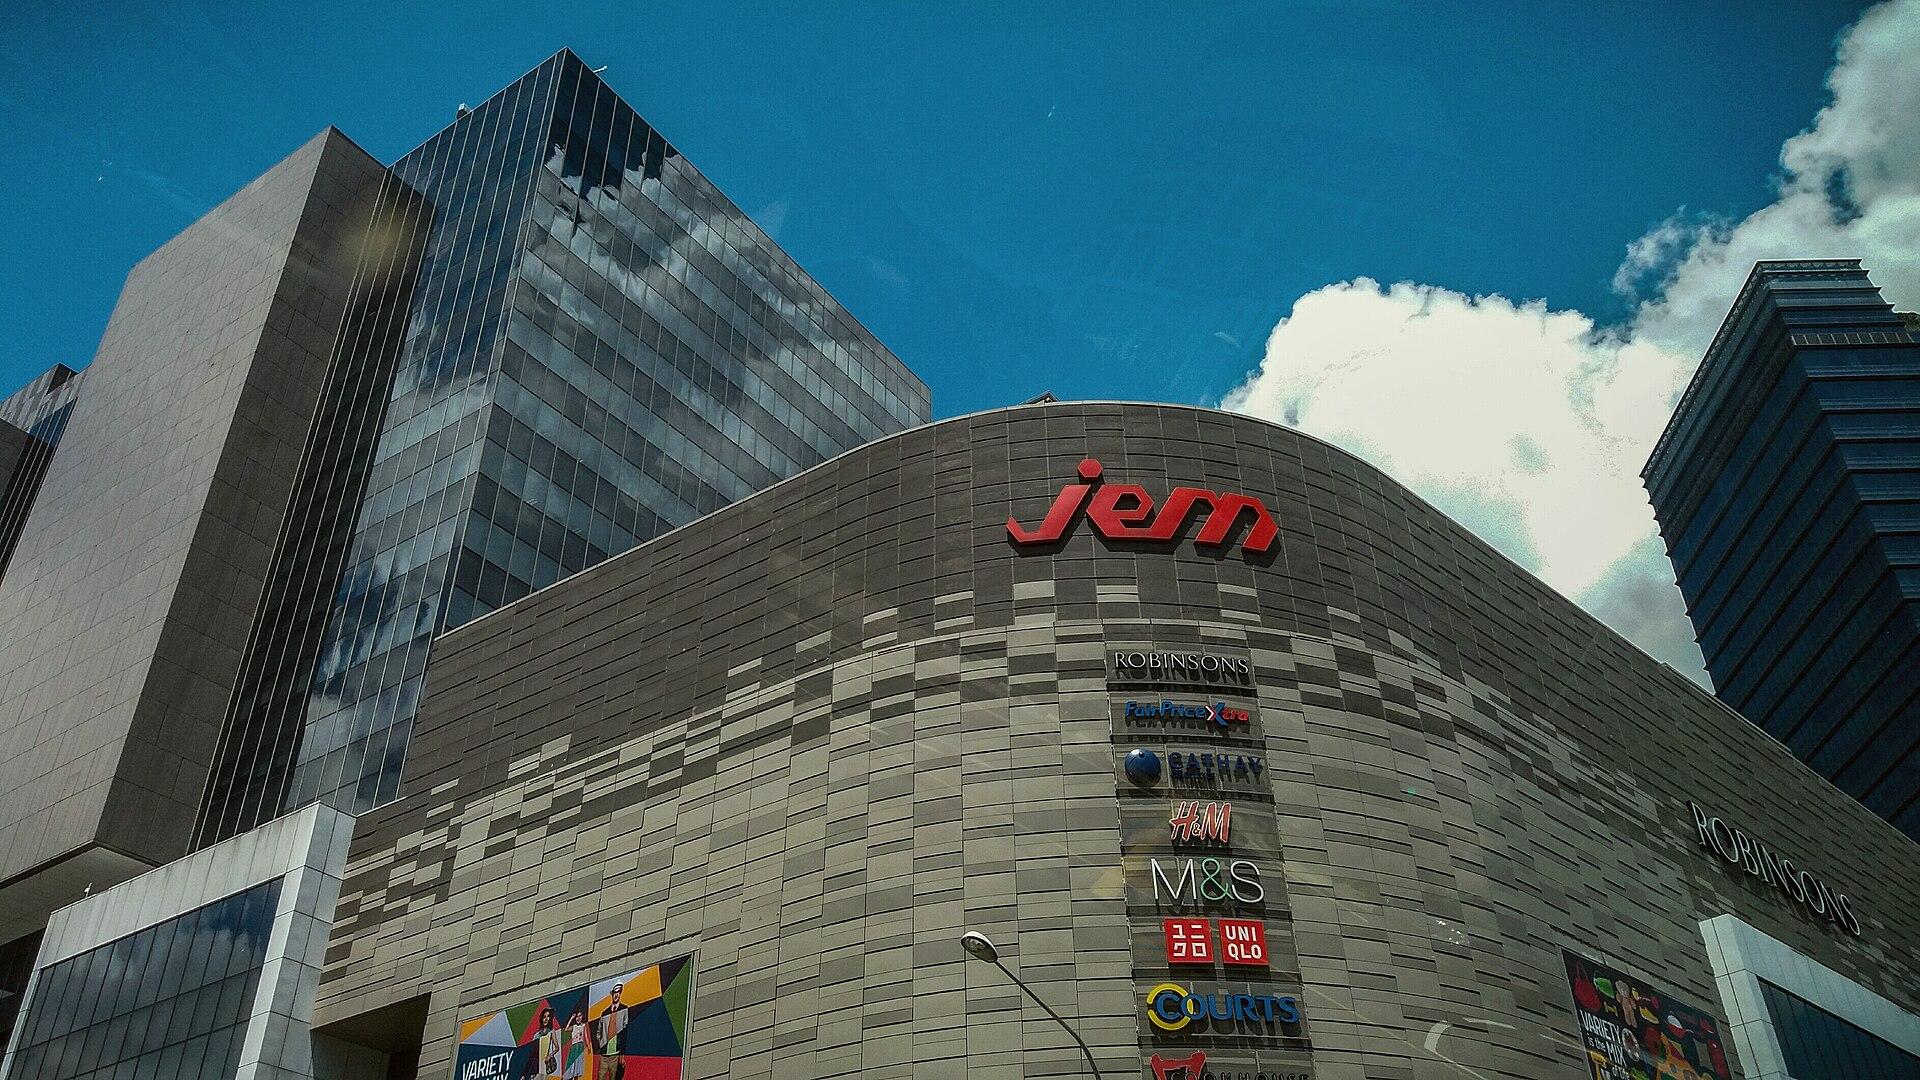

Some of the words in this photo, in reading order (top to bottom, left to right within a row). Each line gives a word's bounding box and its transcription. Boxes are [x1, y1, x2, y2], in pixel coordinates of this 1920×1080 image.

[1005, 458, 1279, 552] jem
[1114, 652, 1249, 675] ROBINSONS
[1168, 752, 1264, 774] CATHAY
[1169, 801, 1232, 843] H&M
[1151, 858, 1264, 903] M&S
[1691, 802, 1861, 936] ROBINSONS
[1225, 925, 1257, 941] UNI
[1227, 943, 1262, 960] QLO
[1147, 985, 1300, 1029] COURTS
[1580, 1009, 1622, 1045] VARIETY
[462, 1050, 514, 1080] VARIETY
[1605, 1041, 1627, 1067] MIX
